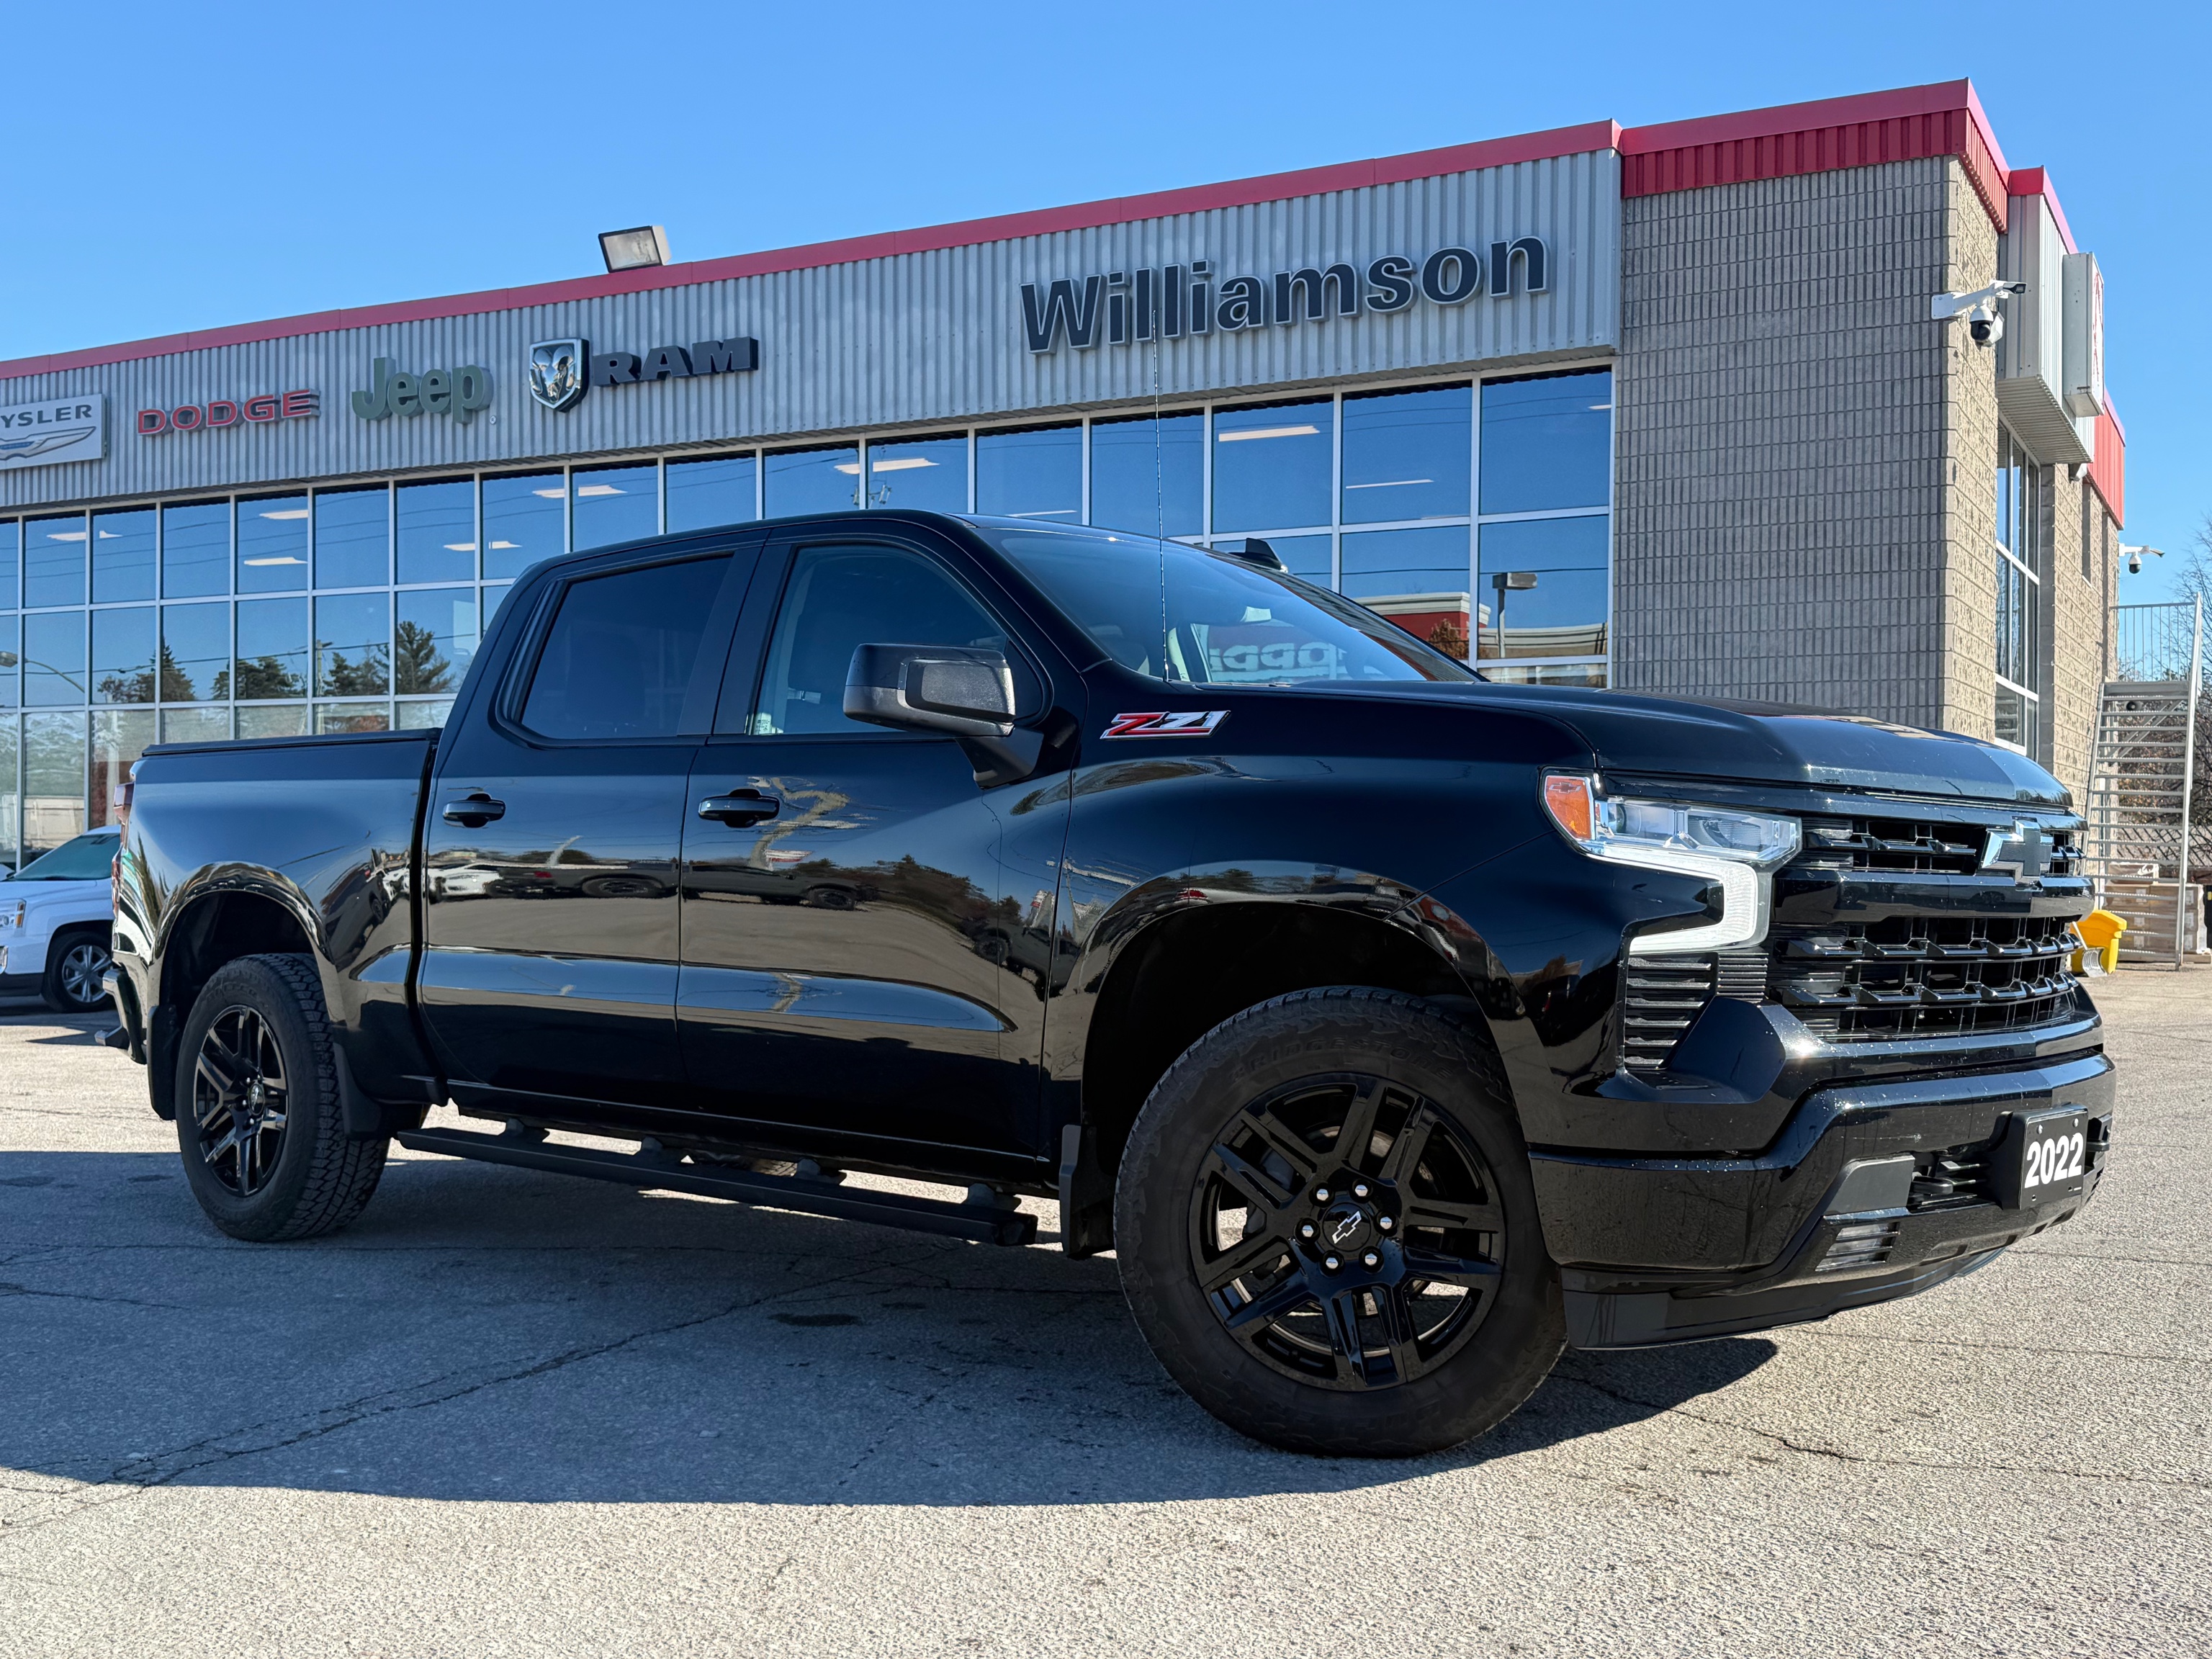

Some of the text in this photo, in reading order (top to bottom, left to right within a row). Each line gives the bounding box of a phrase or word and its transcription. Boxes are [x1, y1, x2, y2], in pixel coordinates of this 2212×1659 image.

[1020, 234, 1551, 356] Williamson
[592, 336, 758, 387] RAM
[137, 388, 320, 435] DODGE
[351, 356, 494, 425] Jeep
[1100, 710, 1231, 740] Z71
[2024, 1133, 2084, 1189] 2022
